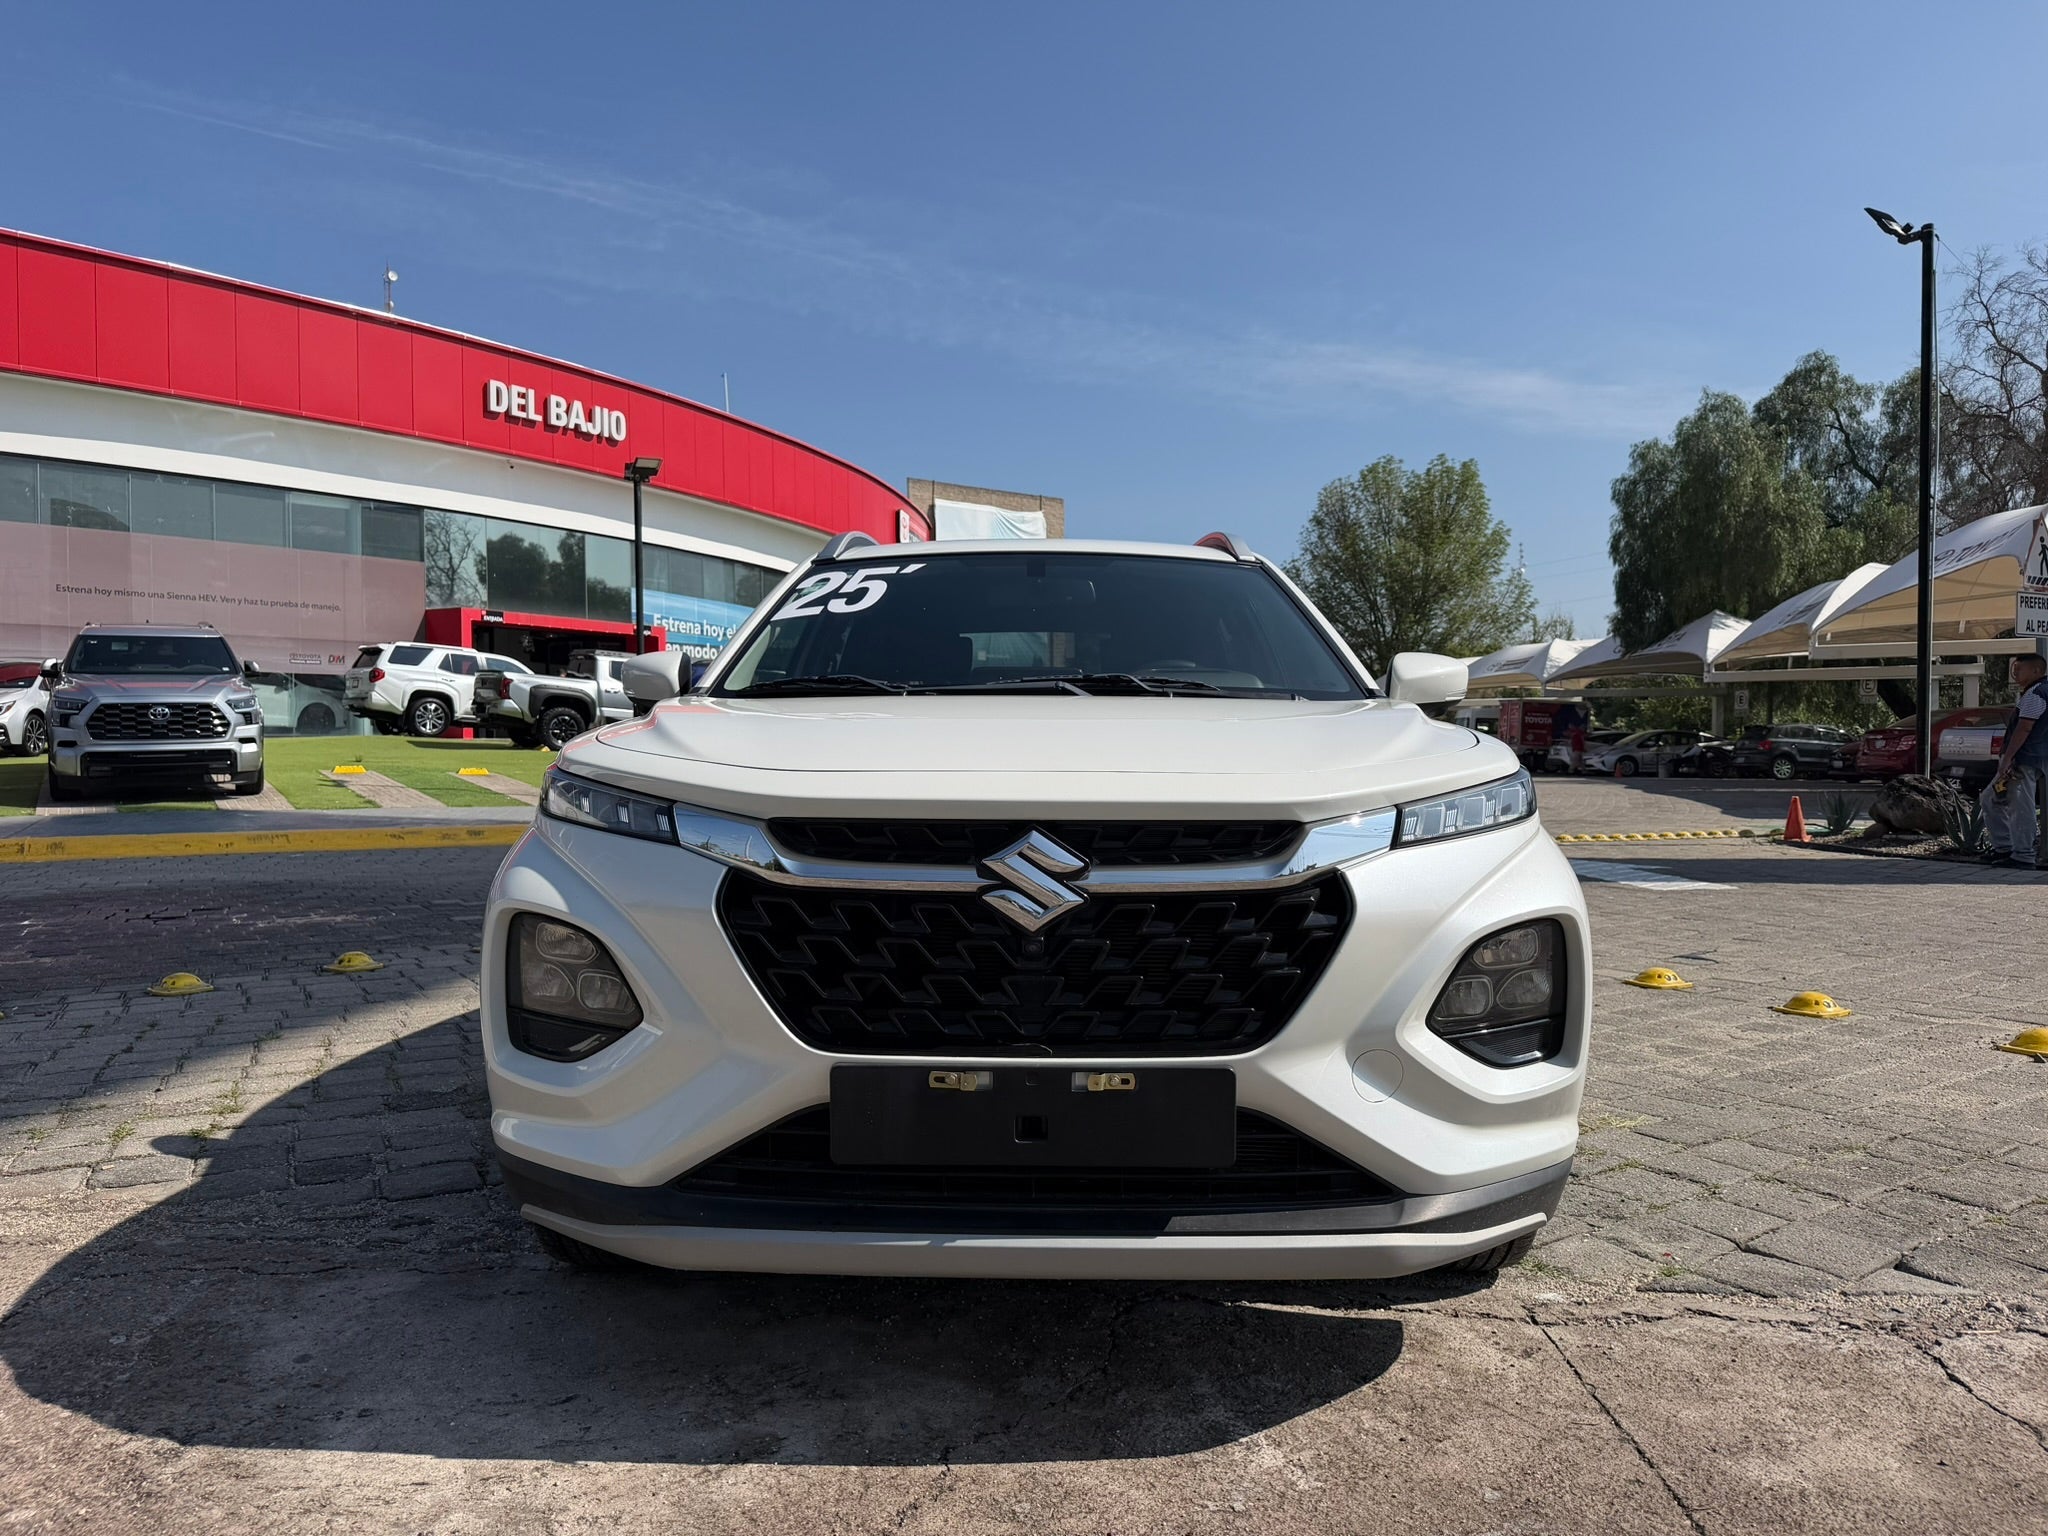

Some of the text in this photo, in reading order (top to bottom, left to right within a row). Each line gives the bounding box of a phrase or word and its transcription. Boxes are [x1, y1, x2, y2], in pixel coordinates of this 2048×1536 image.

[487, 379, 627, 441] DEL BAJIO
[56, 584, 92, 595] Estrena
[95, 586, 112, 597] hoy
[114, 588, 145, 598] mismo
[167, 591, 197, 601] Sienna
[198, 594, 218, 603] HEV.
[220, 596, 236, 604] Ven
[237, 598, 243, 606] y
[244, 598, 258, 606] haz
[260, 599, 269, 607] tu
[270, 600, 298, 609] prueba
[300, 601, 310, 609] de
[311, 603, 341, 612] manejo.
[653, 613, 701, 635] Estrena
[703, 619, 725, 641] hoy
[2025, 619, 2035, 633] AL
[683, 642, 718, 660] modo
[1524, 716, 1552, 725] TOYOTA
